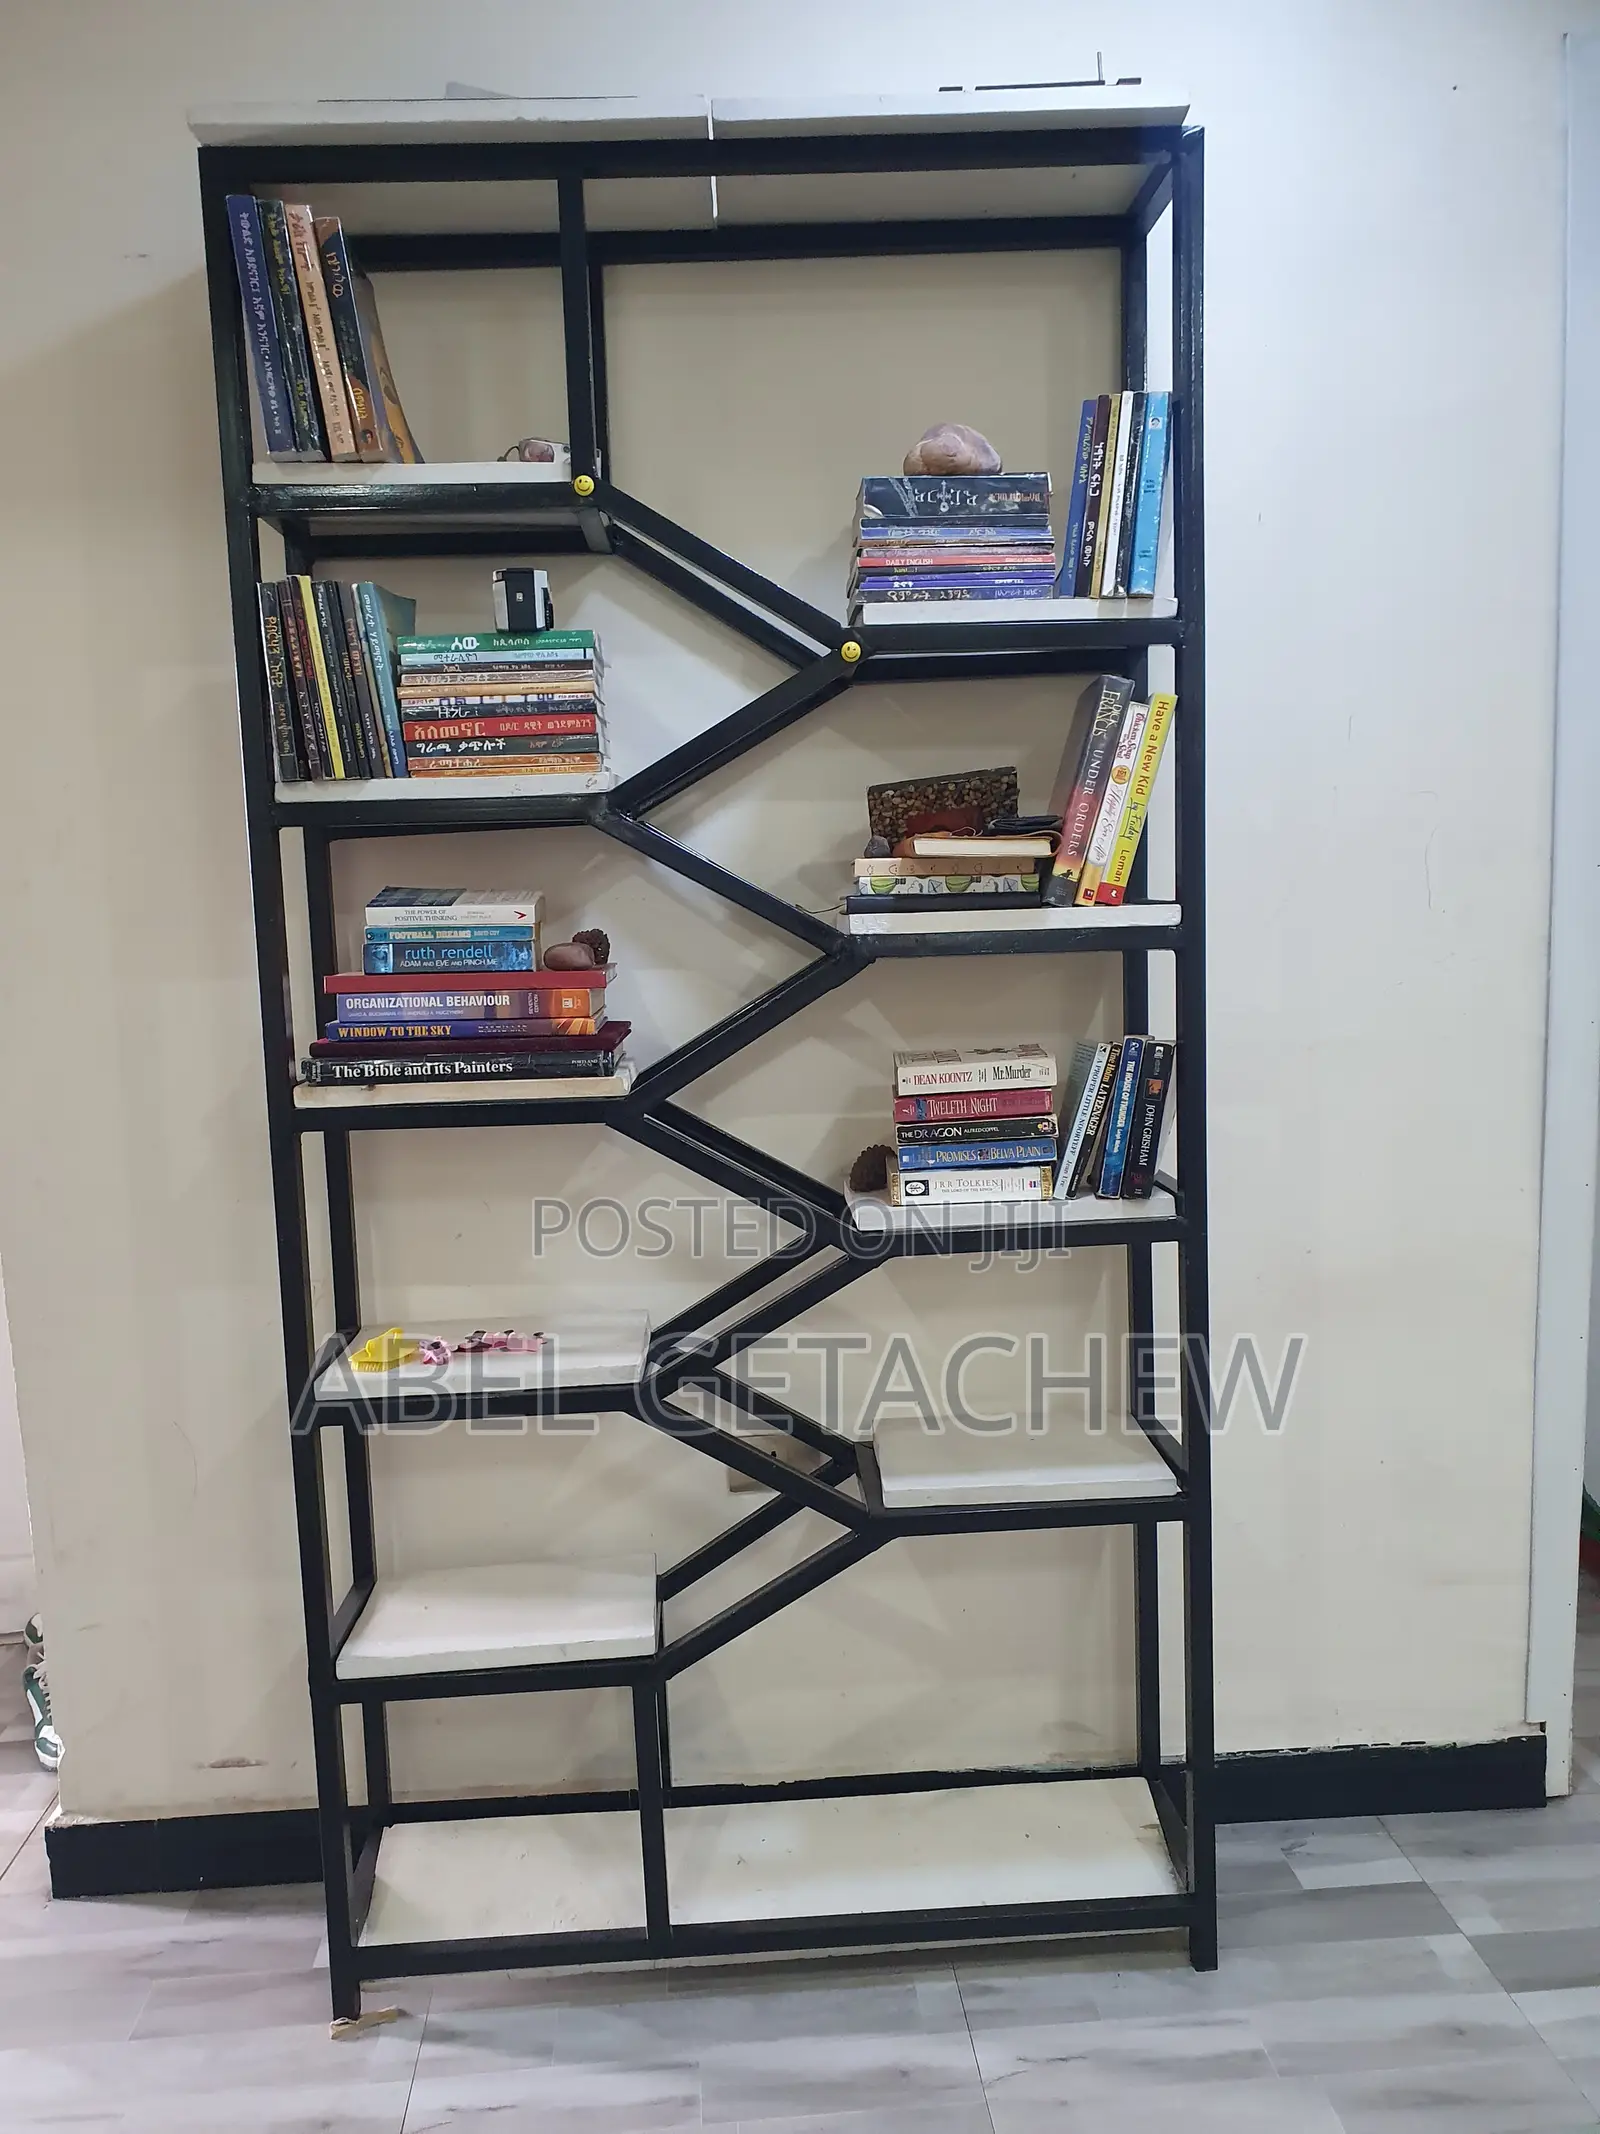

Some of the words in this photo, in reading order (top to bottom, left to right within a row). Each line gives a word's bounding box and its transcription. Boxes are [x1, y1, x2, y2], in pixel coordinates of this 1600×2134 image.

[1092, 689, 1121, 737] FRANCIS
[1107, 703, 1122, 727] DICK
[1150, 701, 1169, 731] Have
[1128, 712, 1145, 741] Chicken
[416, 741, 452, 753] ግራጫ
[458, 738, 506, 753] ቃጭሎች
[1123, 741, 1135, 759] Soup
[1140, 744, 1158, 773] New
[1083, 750, 1103, 796] UNDER
[1135, 775, 1151, 796] Kid
[1129, 801, 1143, 810] by
[1067, 803, 1088, 856] ORDERS
[1125, 816, 1141, 841] Friday
[1113, 850, 1130, 882] Leman
[389, 931, 434, 939] FOOTBALL
[436, 930, 471, 938] DREAMS
[405, 947, 435, 959] ruth
[441, 945, 493, 958] rendell
[435, 959, 449, 967] EVE
[346, 996, 443, 1009] ORGANIZATIONAL
[446, 994, 510, 1007] BEHAVIOUR
[338, 1026, 386, 1037] WINDOW
[390, 1026, 402, 1037] TO
[405, 1026, 428, 1036] THE
[430, 1026, 452, 1036] SKY
[332, 1065, 360, 1078] The
[364, 1064, 401, 1077] Bible
[404, 1064, 431, 1075] and
[435, 1064, 451, 1074] its
[455, 1061, 513, 1074] Painters
[1005, 1066, 1032, 1079] Murder
[1126, 1060, 1135, 1071] THE
[914, 1074, 938, 1085] DEAN
[939, 1072, 973, 1084] KOONTZ
[1088, 1065, 1101, 1094] PROPER
[1122, 1073, 1133, 1091] HOUSE
[1121, 1092, 1130, 1100] OF
[927, 1099, 967, 1117] TWELFTH
[971, 1098, 997, 1114] NIGHT
[1081, 1094, 1092, 1117] LITTLE
[1116, 1100, 1128, 1128] THUNDER
[1144, 1104, 1155, 1127] JOHN
[915, 1127, 962, 1138] DRAGON
[936, 1150, 976, 1162] PROMISES
[990, 1147, 1014, 1160] BELVA
[1016, 1146, 1041, 1158] PLAIN
[1139, 1128, 1151, 1166] GRISHAM
[955, 1179, 1000, 1187] TOLKIEN
